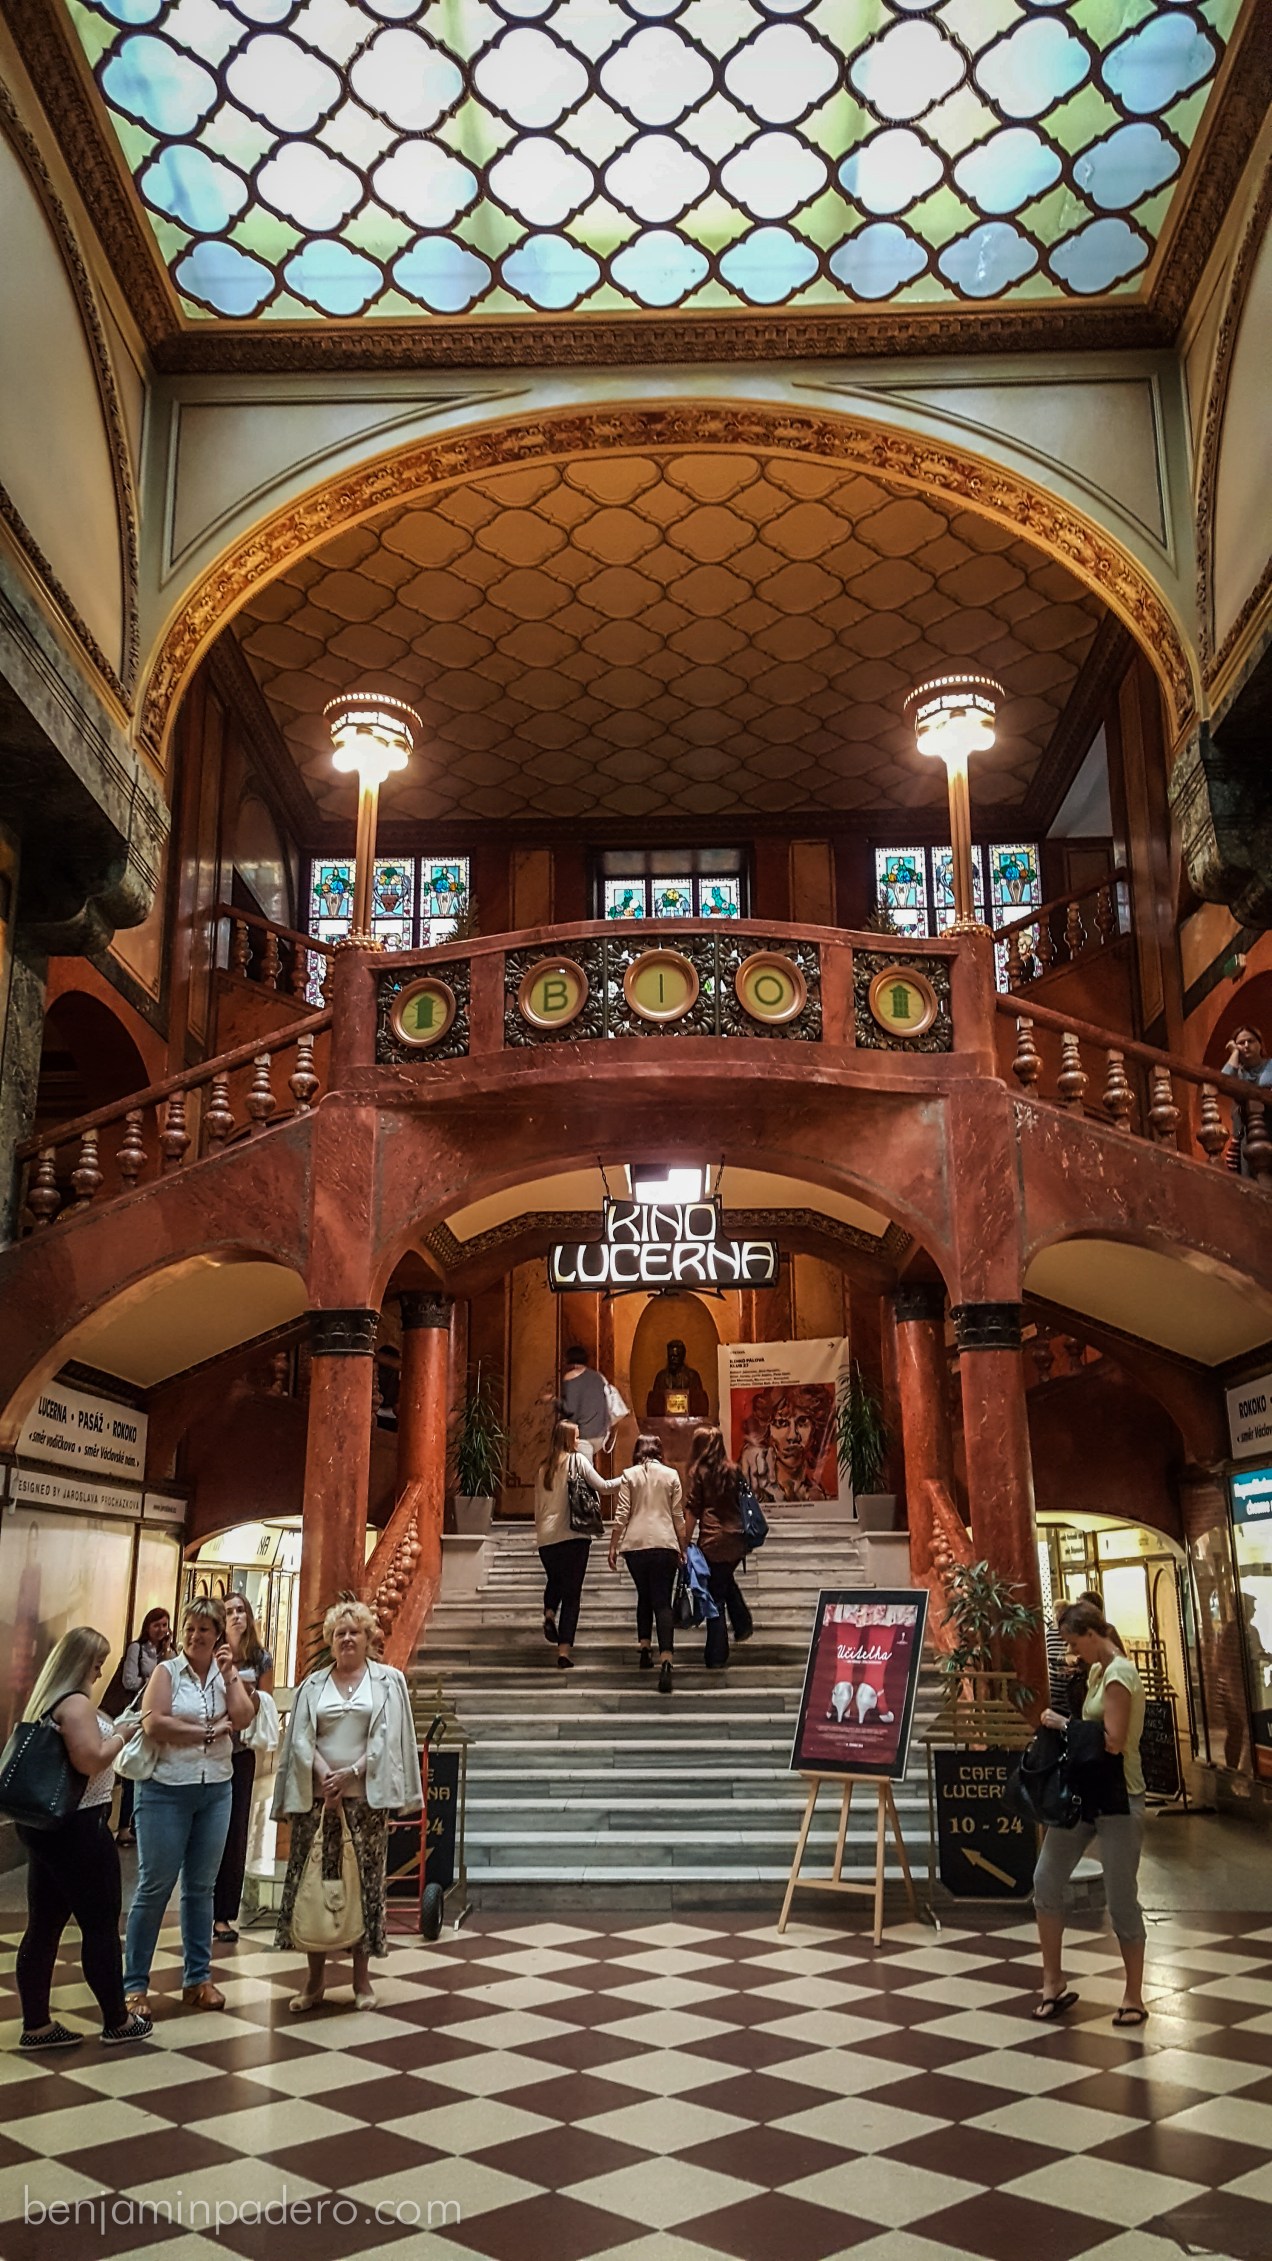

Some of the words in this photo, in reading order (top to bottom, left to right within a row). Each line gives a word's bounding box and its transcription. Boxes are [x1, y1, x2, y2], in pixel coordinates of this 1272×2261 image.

[607, 1204, 717, 1242] KINO
[554, 1241, 775, 1282] LUCERNA
[1238, 1395, 1267, 1419] ROKOKO
[38, 1396, 67, 1424] LUCERNA
[78, 1410, 104, 1433] PASÁŽ
[112, 1420, 137, 1443] ROKOKO
[32, 1429, 46, 1446] směr
[84, 1443, 99, 1457] směr
[18, 1480, 50, 1496] ESIGNED
[52, 1486, 61, 1498] BY
[62, 1488, 98, 1504] JAROSLAVA
[837, 1644, 893, 1660] Učitelka
[959, 1767, 1008, 1781] CAFE
[943, 1784, 1006, 1799] LUCER
[949, 1816, 976, 1834] 10
[997, 1815, 1024, 1834] 24
